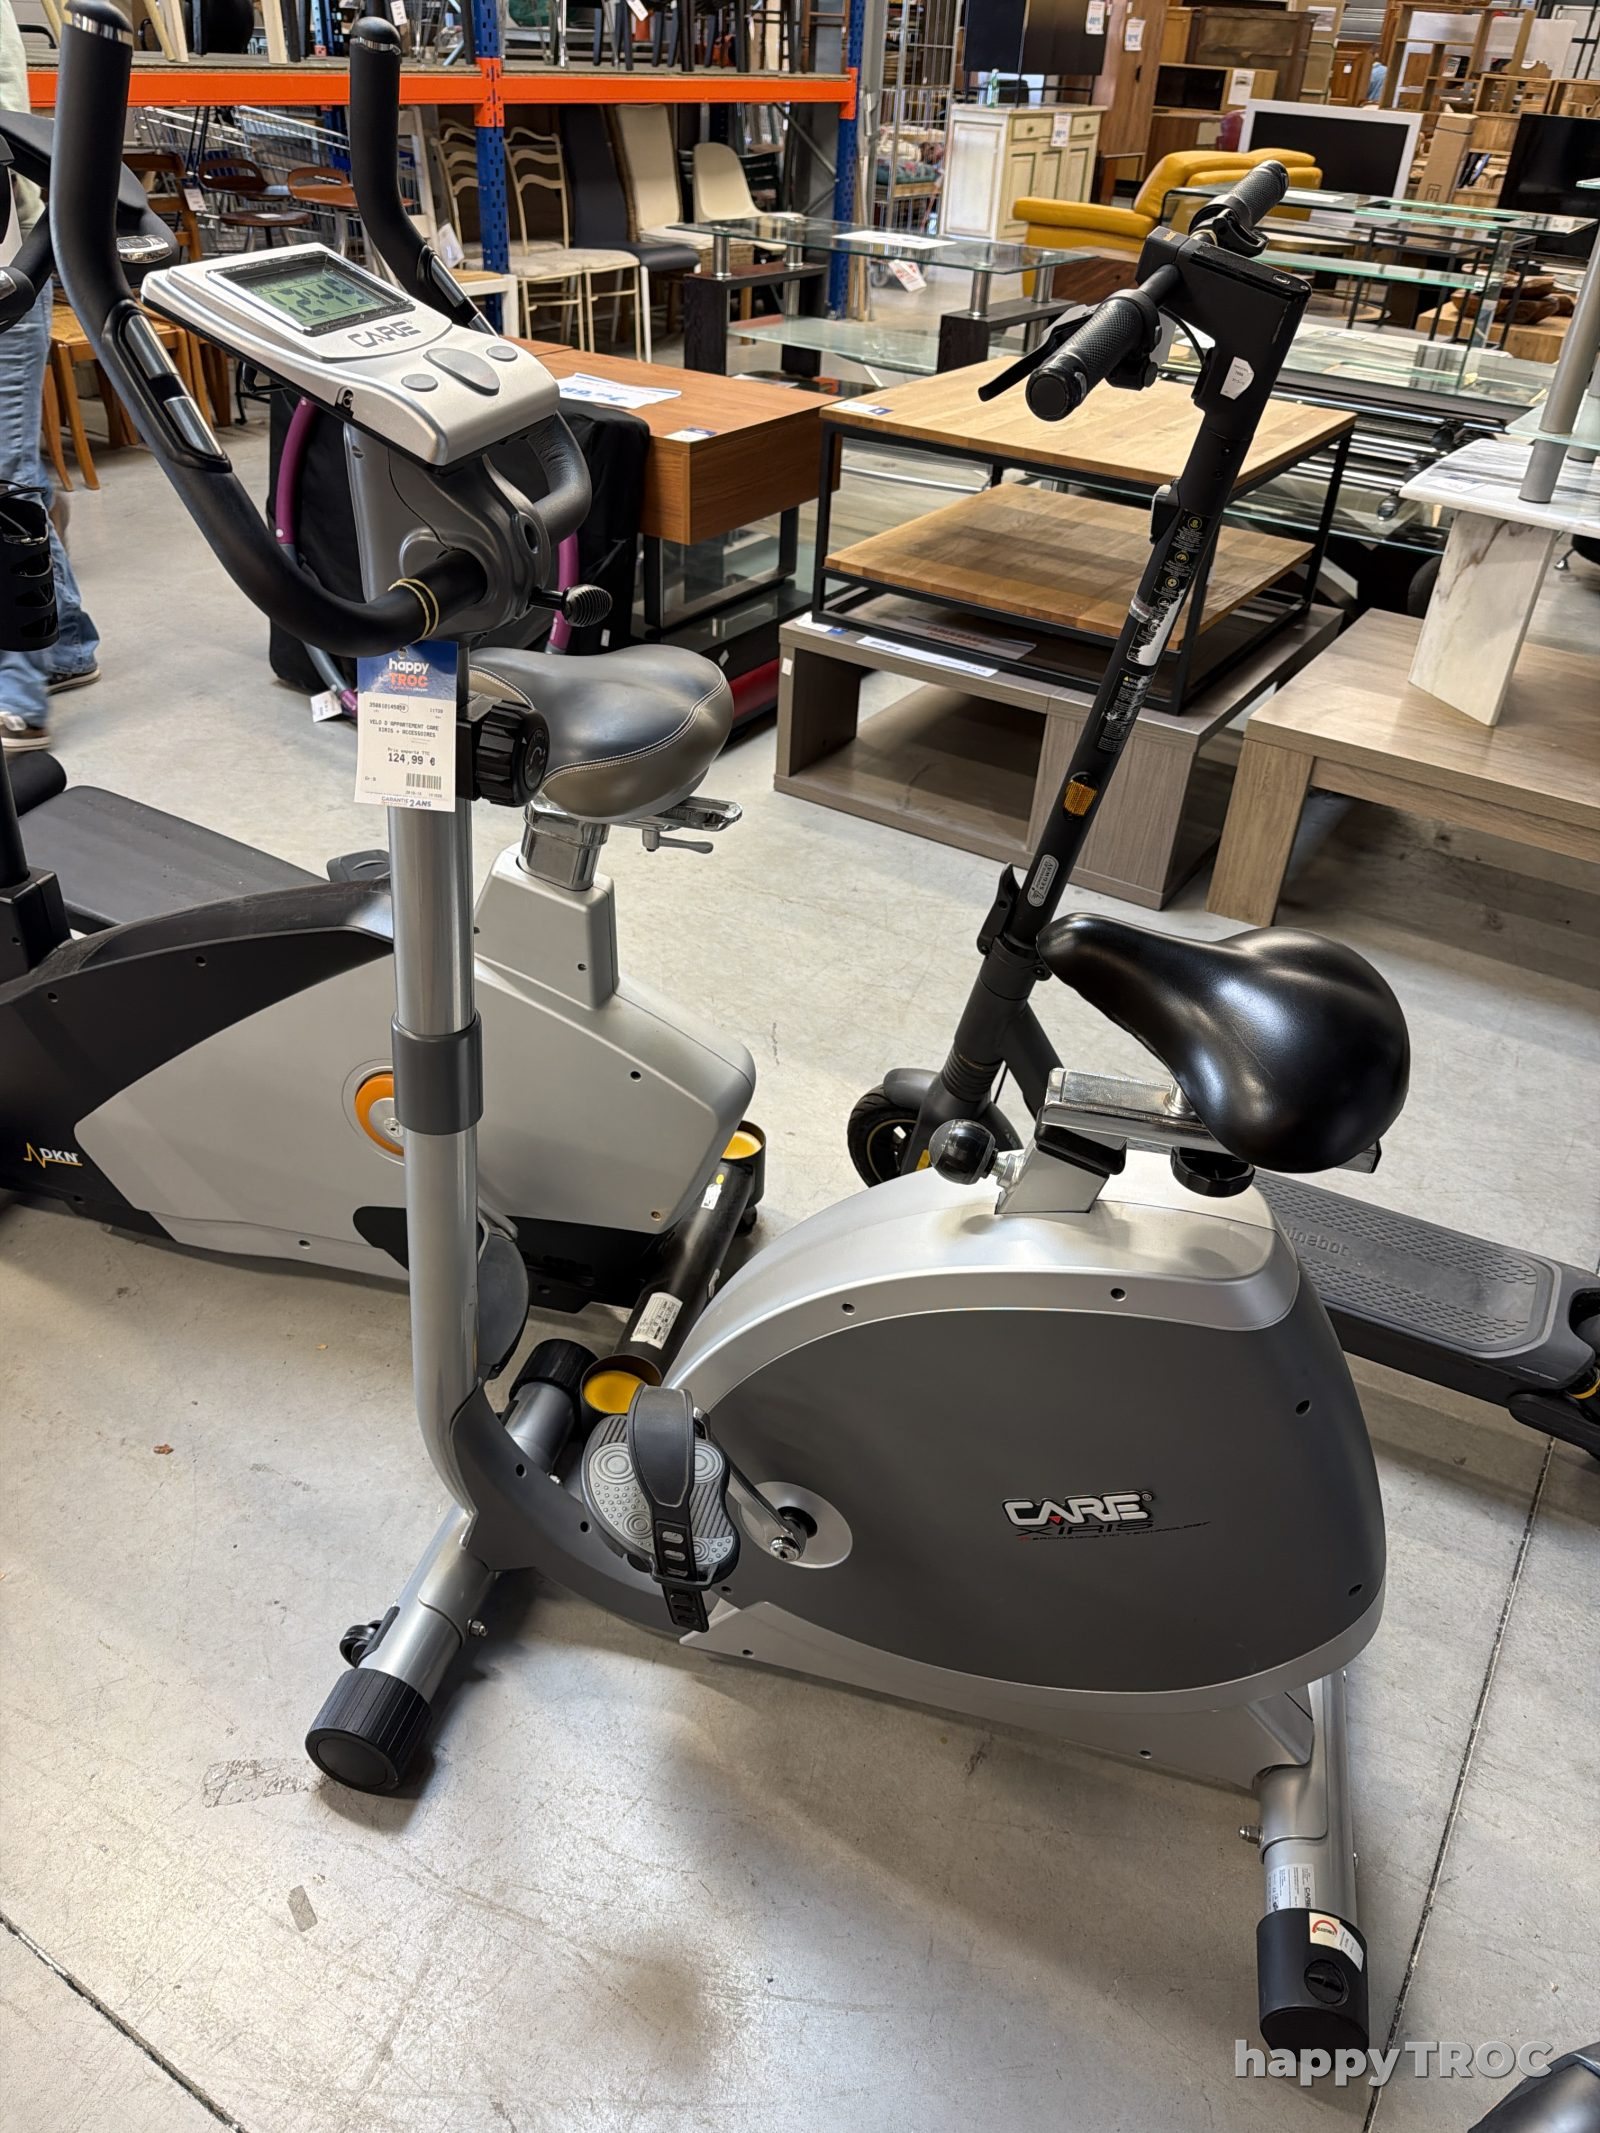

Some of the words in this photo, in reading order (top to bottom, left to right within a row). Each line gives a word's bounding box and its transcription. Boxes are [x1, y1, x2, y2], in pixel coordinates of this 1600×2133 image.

[347, 320, 421, 348] CARE
[388, 657, 430, 675] happy
[389, 672, 428, 688] TROC
[390, 721, 424, 729] APPARTEMENT
[401, 729, 436, 738] ACCESSOIRES
[388, 752, 424, 766] 124,99
[429, 757, 436, 767] €
[381, 796, 409, 804] GARANTIE
[415, 800, 432, 808] ANS
[39, 1147, 78, 1163] DKN
[1003, 1491, 1150, 1526] CARE
[1015, 1520, 1154, 1537] XIRIS
